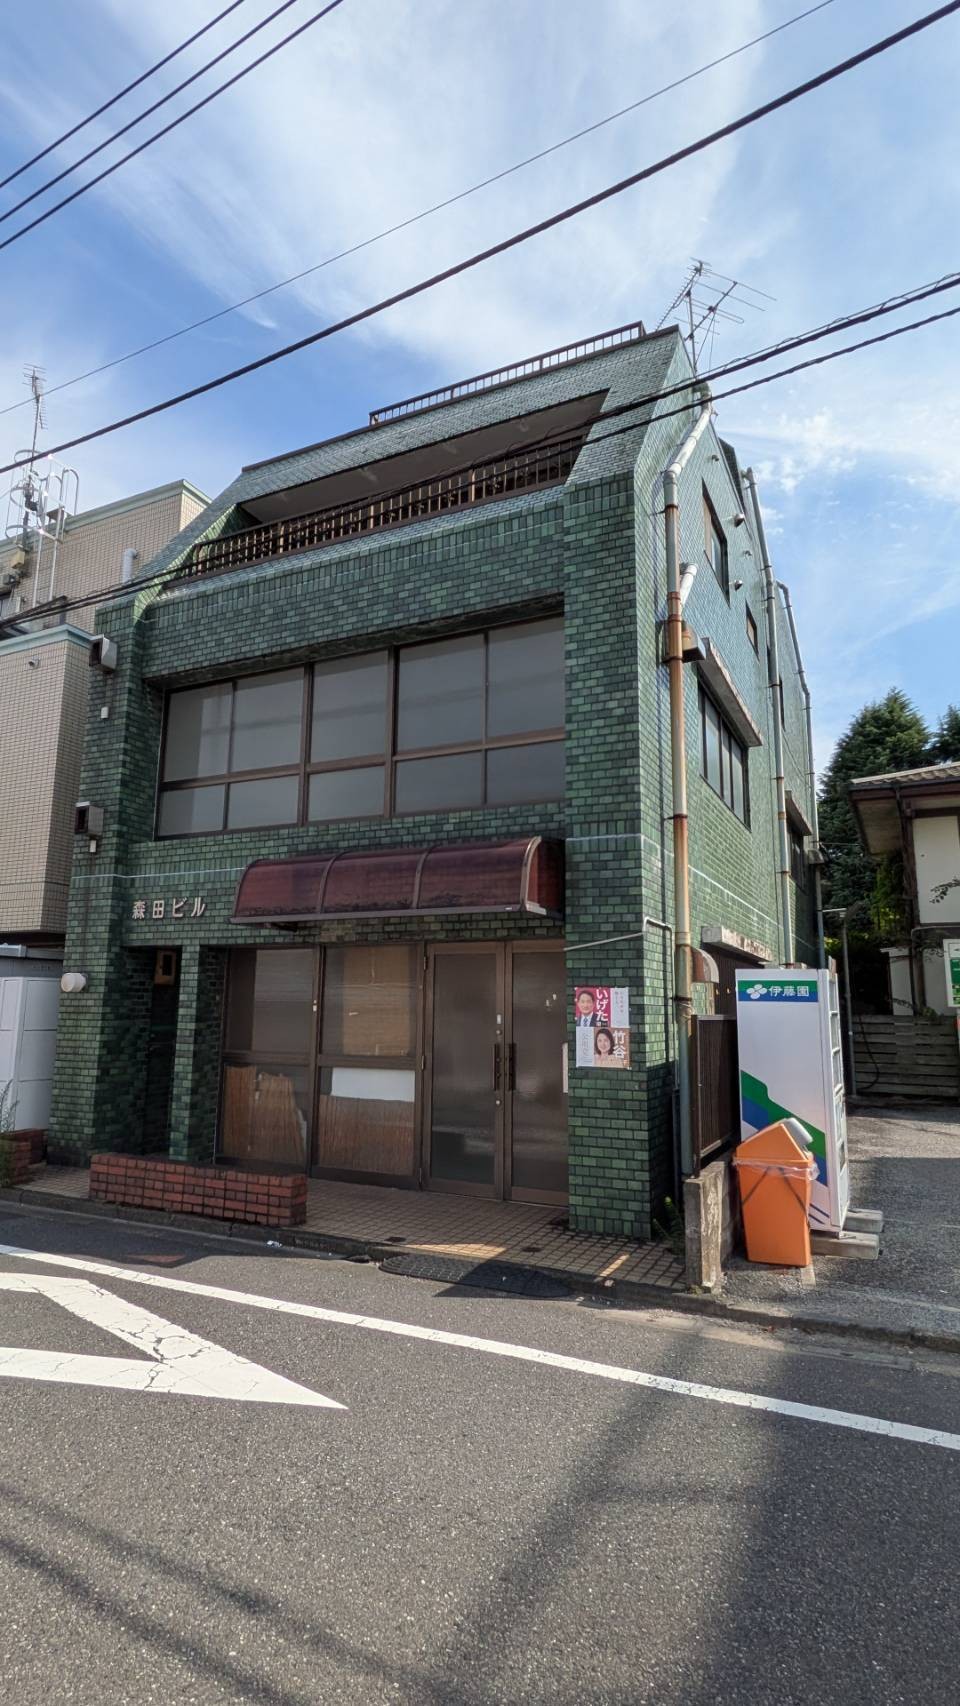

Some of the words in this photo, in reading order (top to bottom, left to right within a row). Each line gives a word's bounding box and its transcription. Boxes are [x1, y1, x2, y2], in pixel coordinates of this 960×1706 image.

[132, 897, 206, 919] 森田ビル
[768, 985, 809, 997] 伊藤園
[596, 989, 609, 1022] いげた
[612, 1030, 627, 1059] 竹谷
